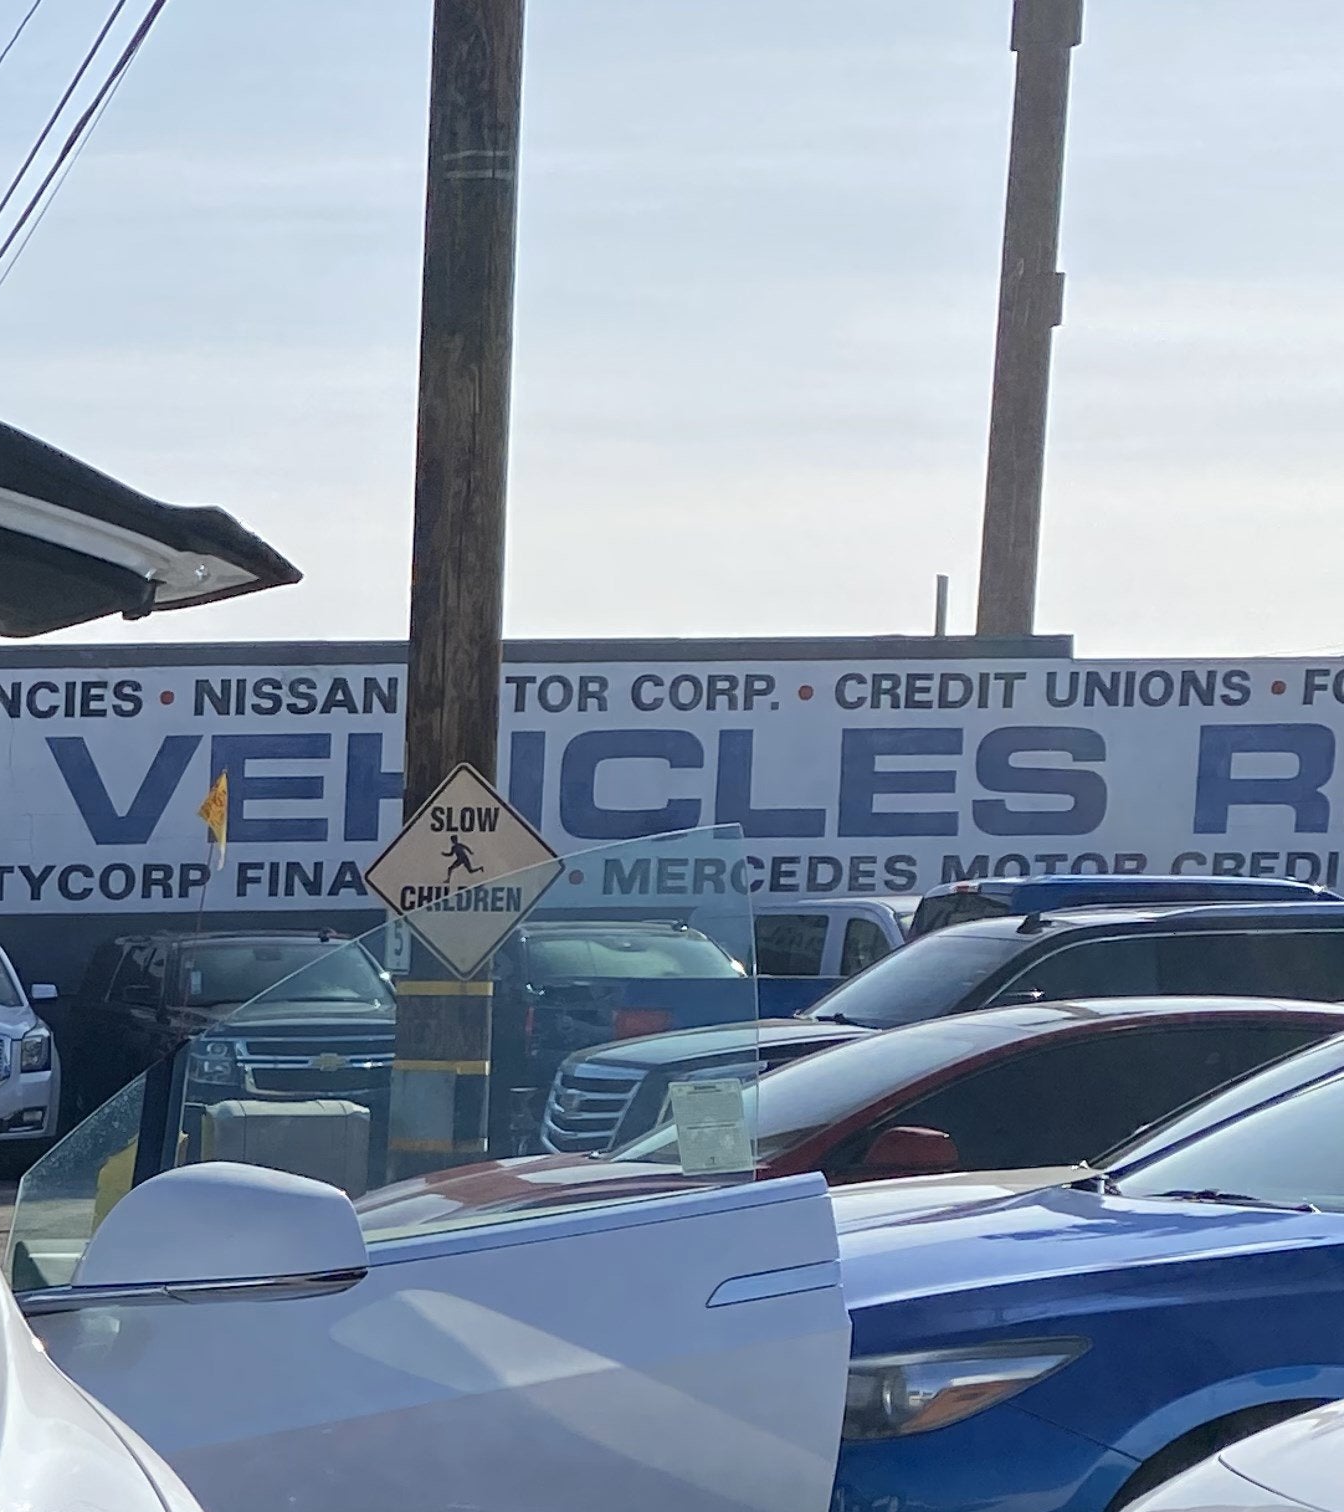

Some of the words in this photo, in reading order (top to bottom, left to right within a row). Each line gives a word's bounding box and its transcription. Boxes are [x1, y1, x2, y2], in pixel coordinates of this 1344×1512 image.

[193, 676, 398, 716] NISSAN
[505, 674, 609, 712] TOR
[631, 673, 780, 711] CORP.
[835, 671, 1027, 709] CREDIT
[1046, 668, 1251, 707] UNIONS
[430, 806, 500, 832] SLOW
[603, 855, 918, 896] MERCEDES
[400, 885, 522, 912] CHILDREN
